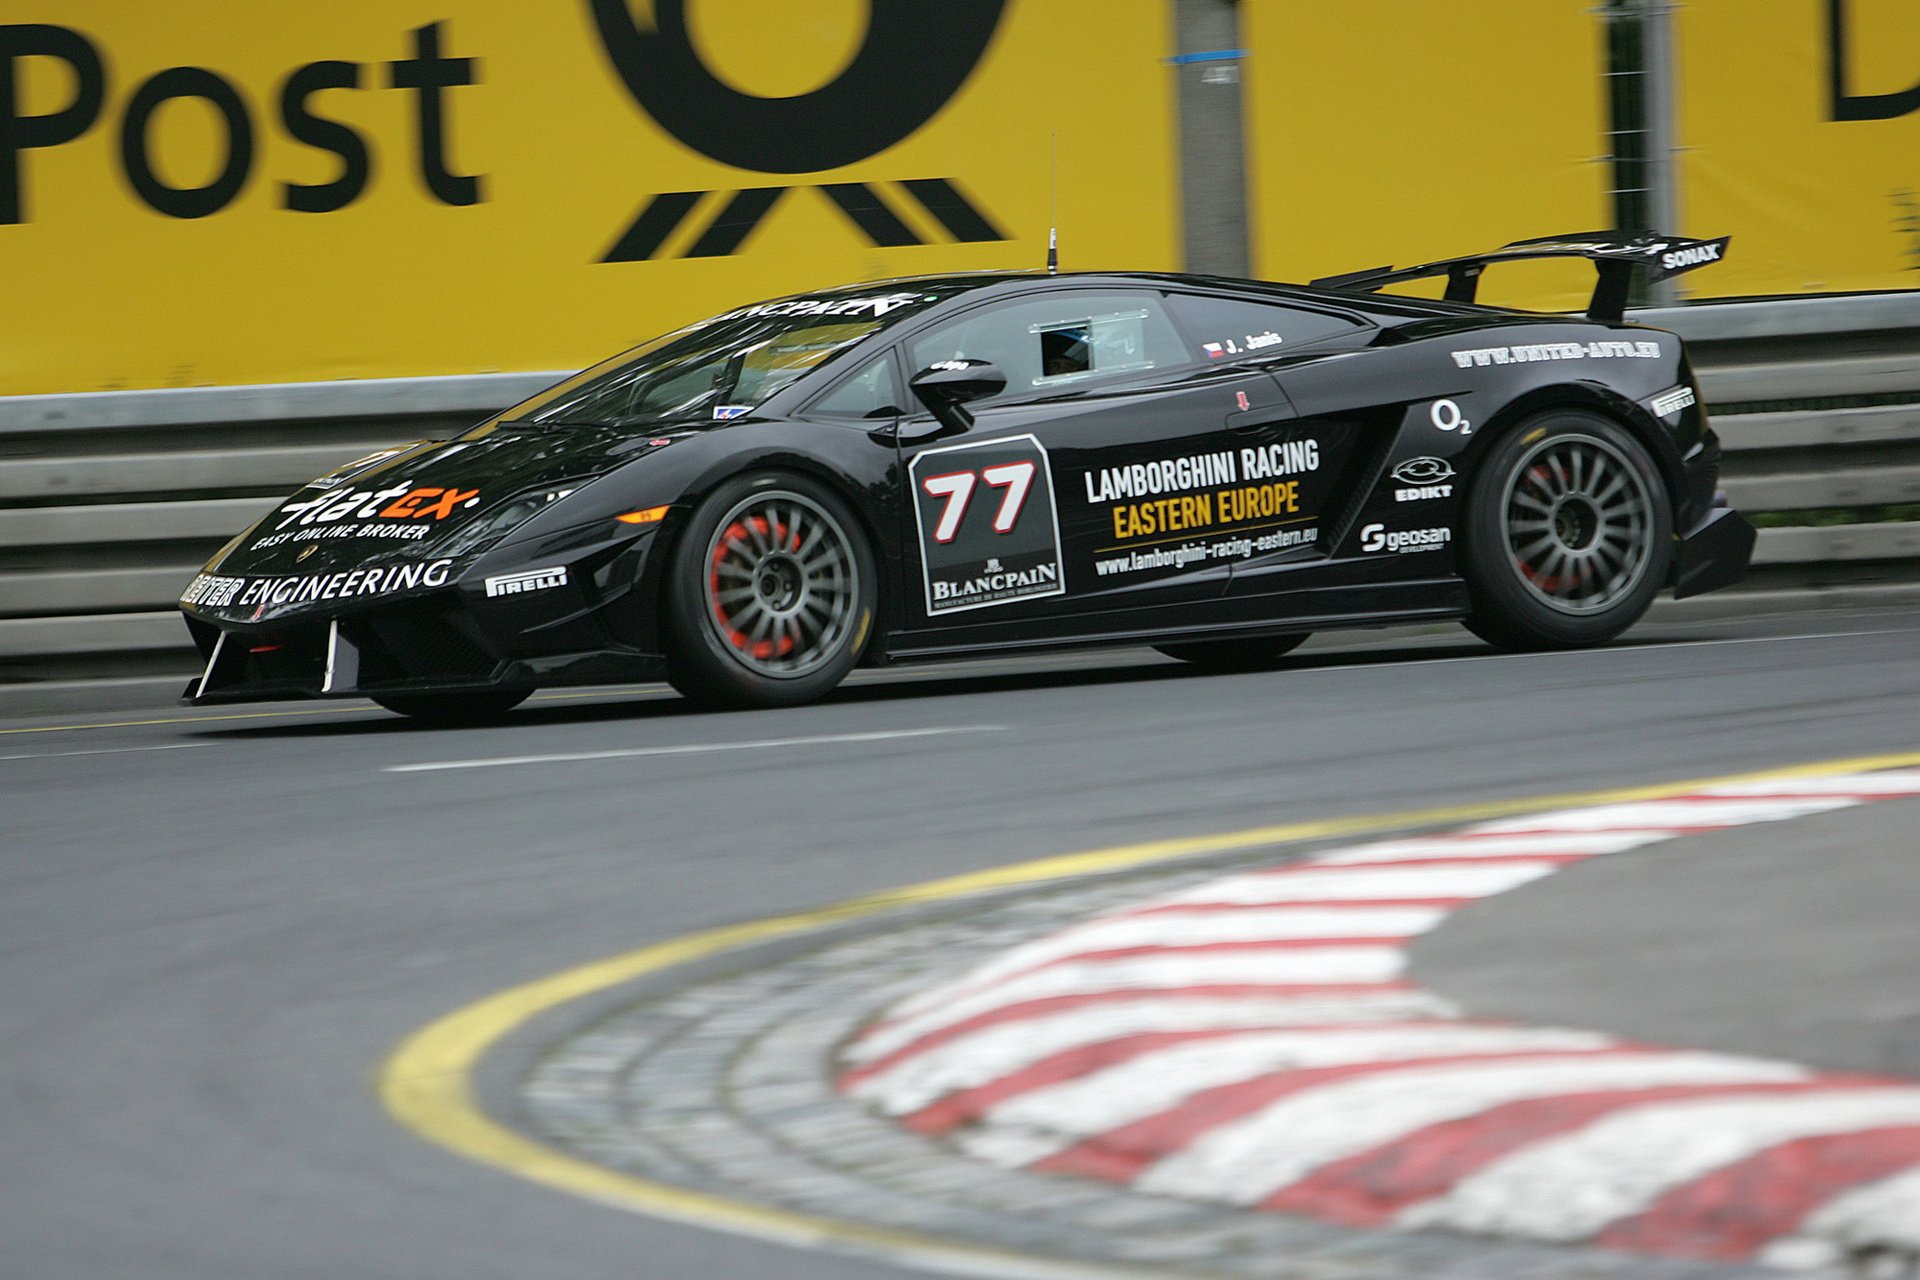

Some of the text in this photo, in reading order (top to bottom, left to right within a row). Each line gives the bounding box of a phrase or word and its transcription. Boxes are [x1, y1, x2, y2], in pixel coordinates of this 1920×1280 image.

[0, 20, 487, 224] Post
[1662, 243, 1720, 269] SONAX
[721, 293, 922, 318] NCPAIN
[1225, 339, 1244, 354] J.
[1650, 387, 1696, 418] PIRELLI
[1084, 438, 1320, 504] LAMBORGHINI RACING
[922, 459, 1037, 544] 77
[1394, 485, 1453, 502] EDIKT
[1112, 481, 1300, 539] EASTERN EUROPE
[250, 523, 431, 551] EASY ONLINE BROKER
[1095, 527, 1318, 576] www.lamborghini-racing-eastern.eu
[1386, 526, 1452, 551] geosan
[179, 559, 453, 607] REITER ENGINEERING
[485, 566, 568, 598] PIRELLI
